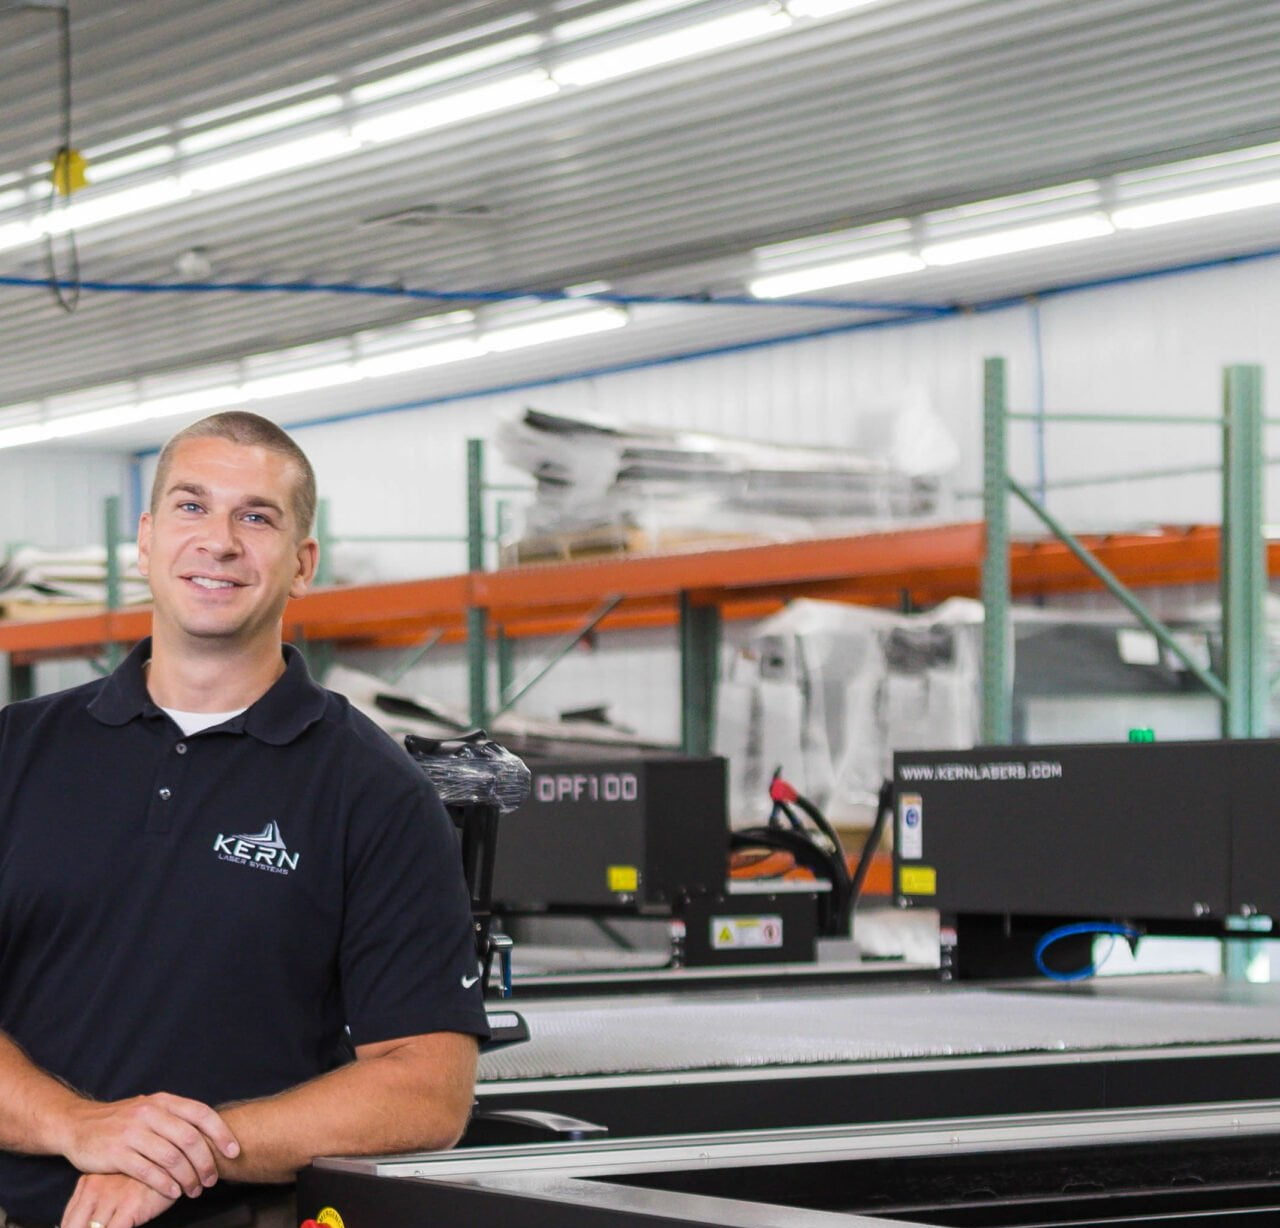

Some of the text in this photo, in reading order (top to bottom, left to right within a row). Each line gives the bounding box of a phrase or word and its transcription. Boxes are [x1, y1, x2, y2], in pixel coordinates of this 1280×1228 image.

[213, 833, 300, 870] KERN
[218, 853, 289, 875] LASER SYSTEMS
